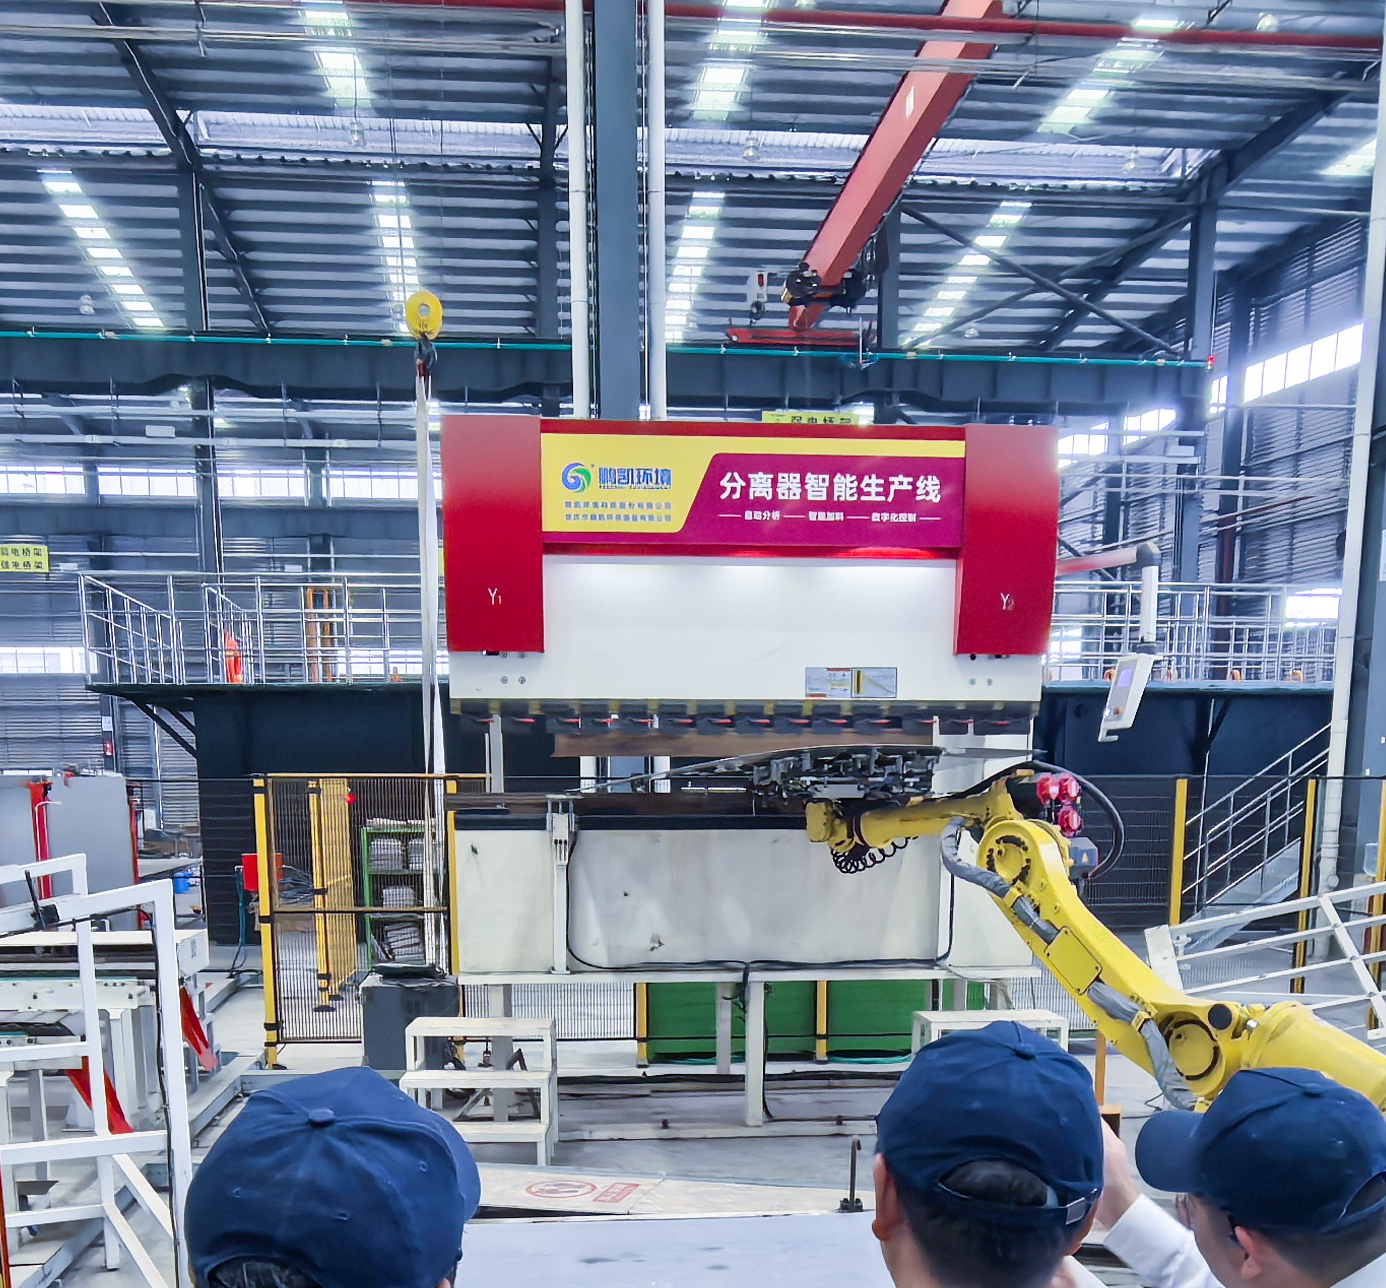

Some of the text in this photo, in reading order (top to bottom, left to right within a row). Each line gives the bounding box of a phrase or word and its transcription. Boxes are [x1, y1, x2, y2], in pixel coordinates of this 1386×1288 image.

[719, 471, 941, 503] 分离器智能生产线
